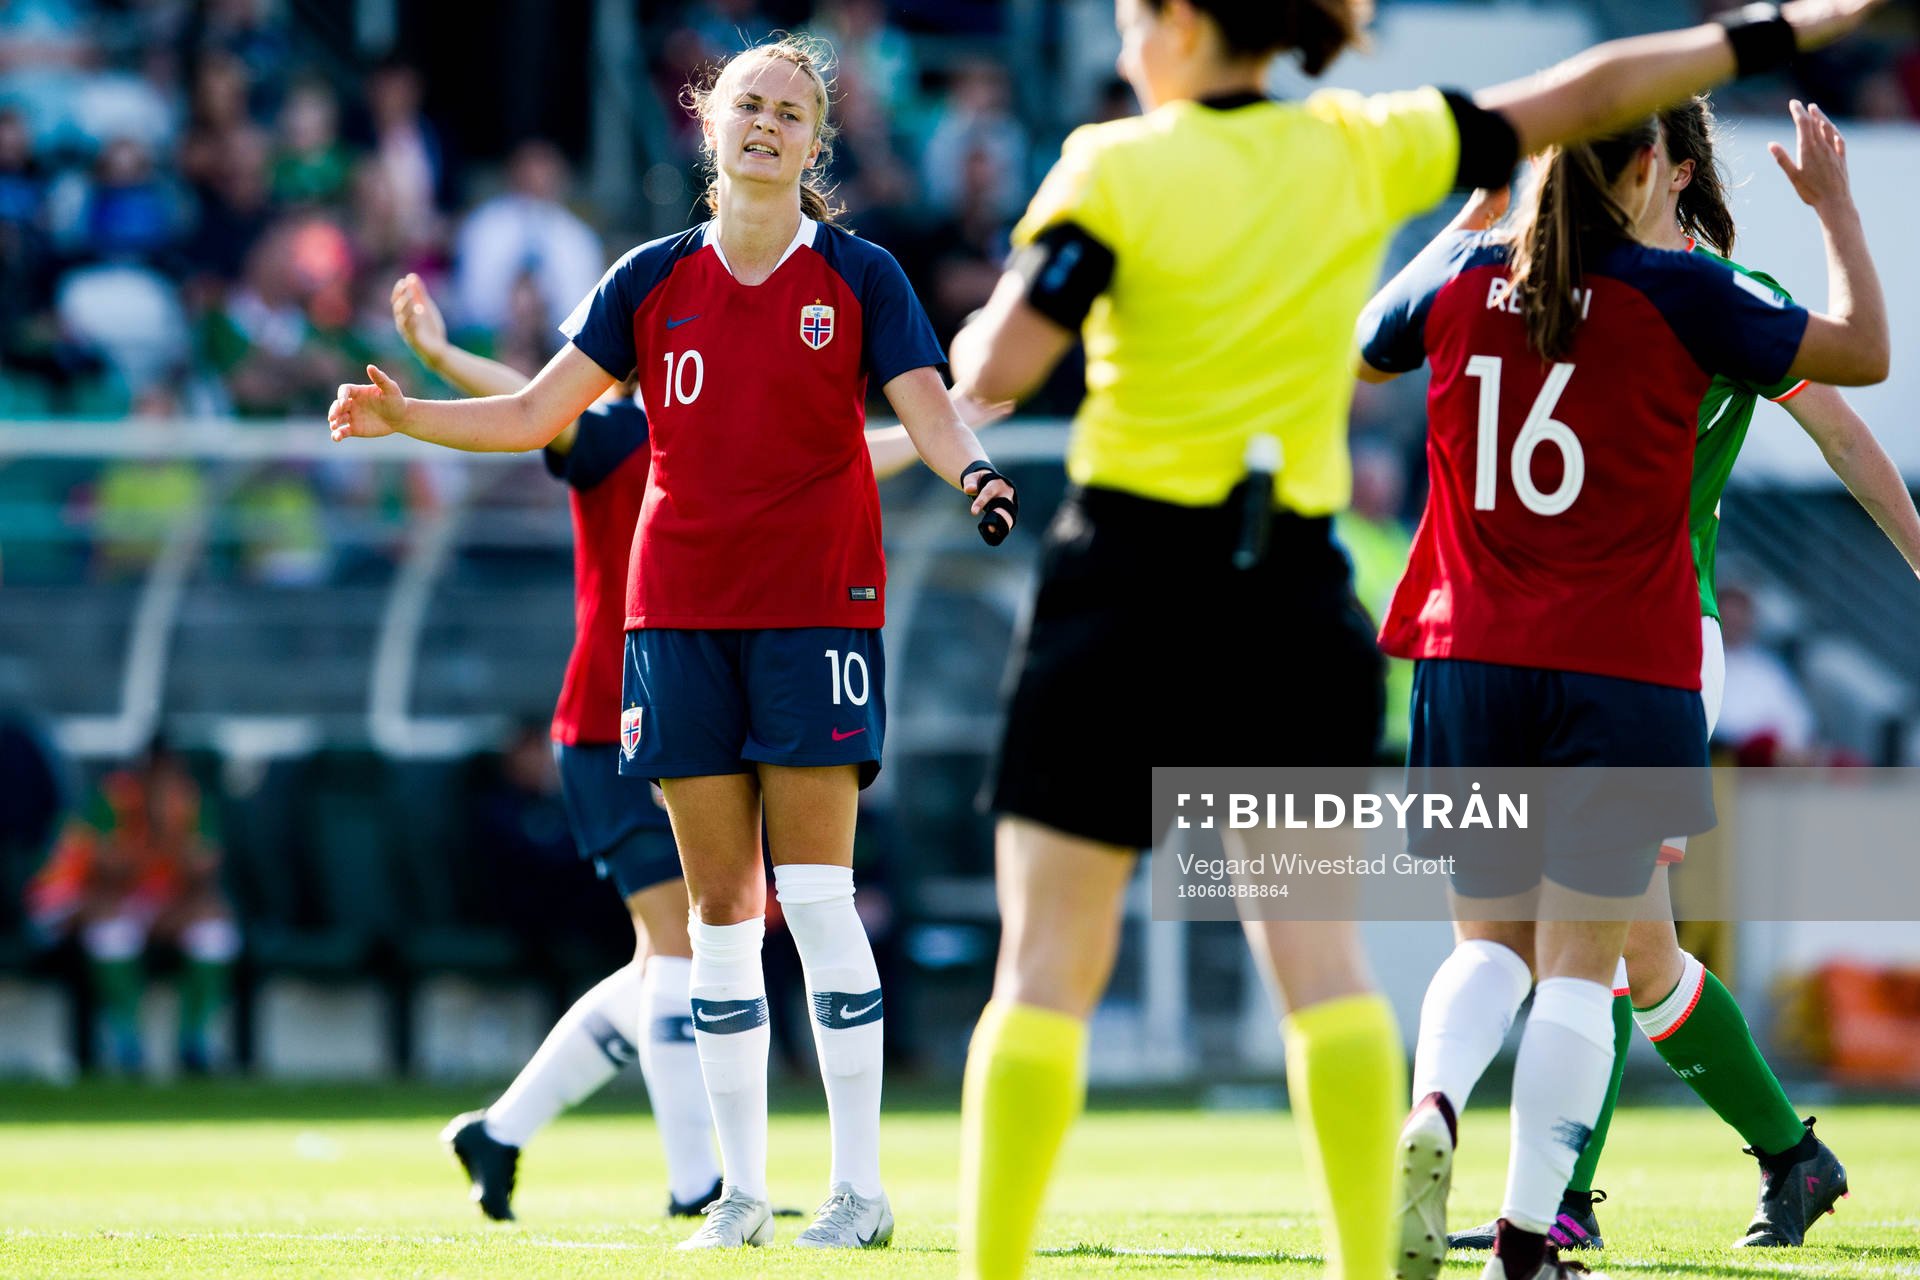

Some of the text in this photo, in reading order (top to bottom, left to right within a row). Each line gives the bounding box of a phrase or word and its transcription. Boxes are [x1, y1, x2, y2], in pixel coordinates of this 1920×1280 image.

[663, 349, 704, 408] 10
[1465, 354, 1585, 516] 16
[825, 649, 869, 706] 10
